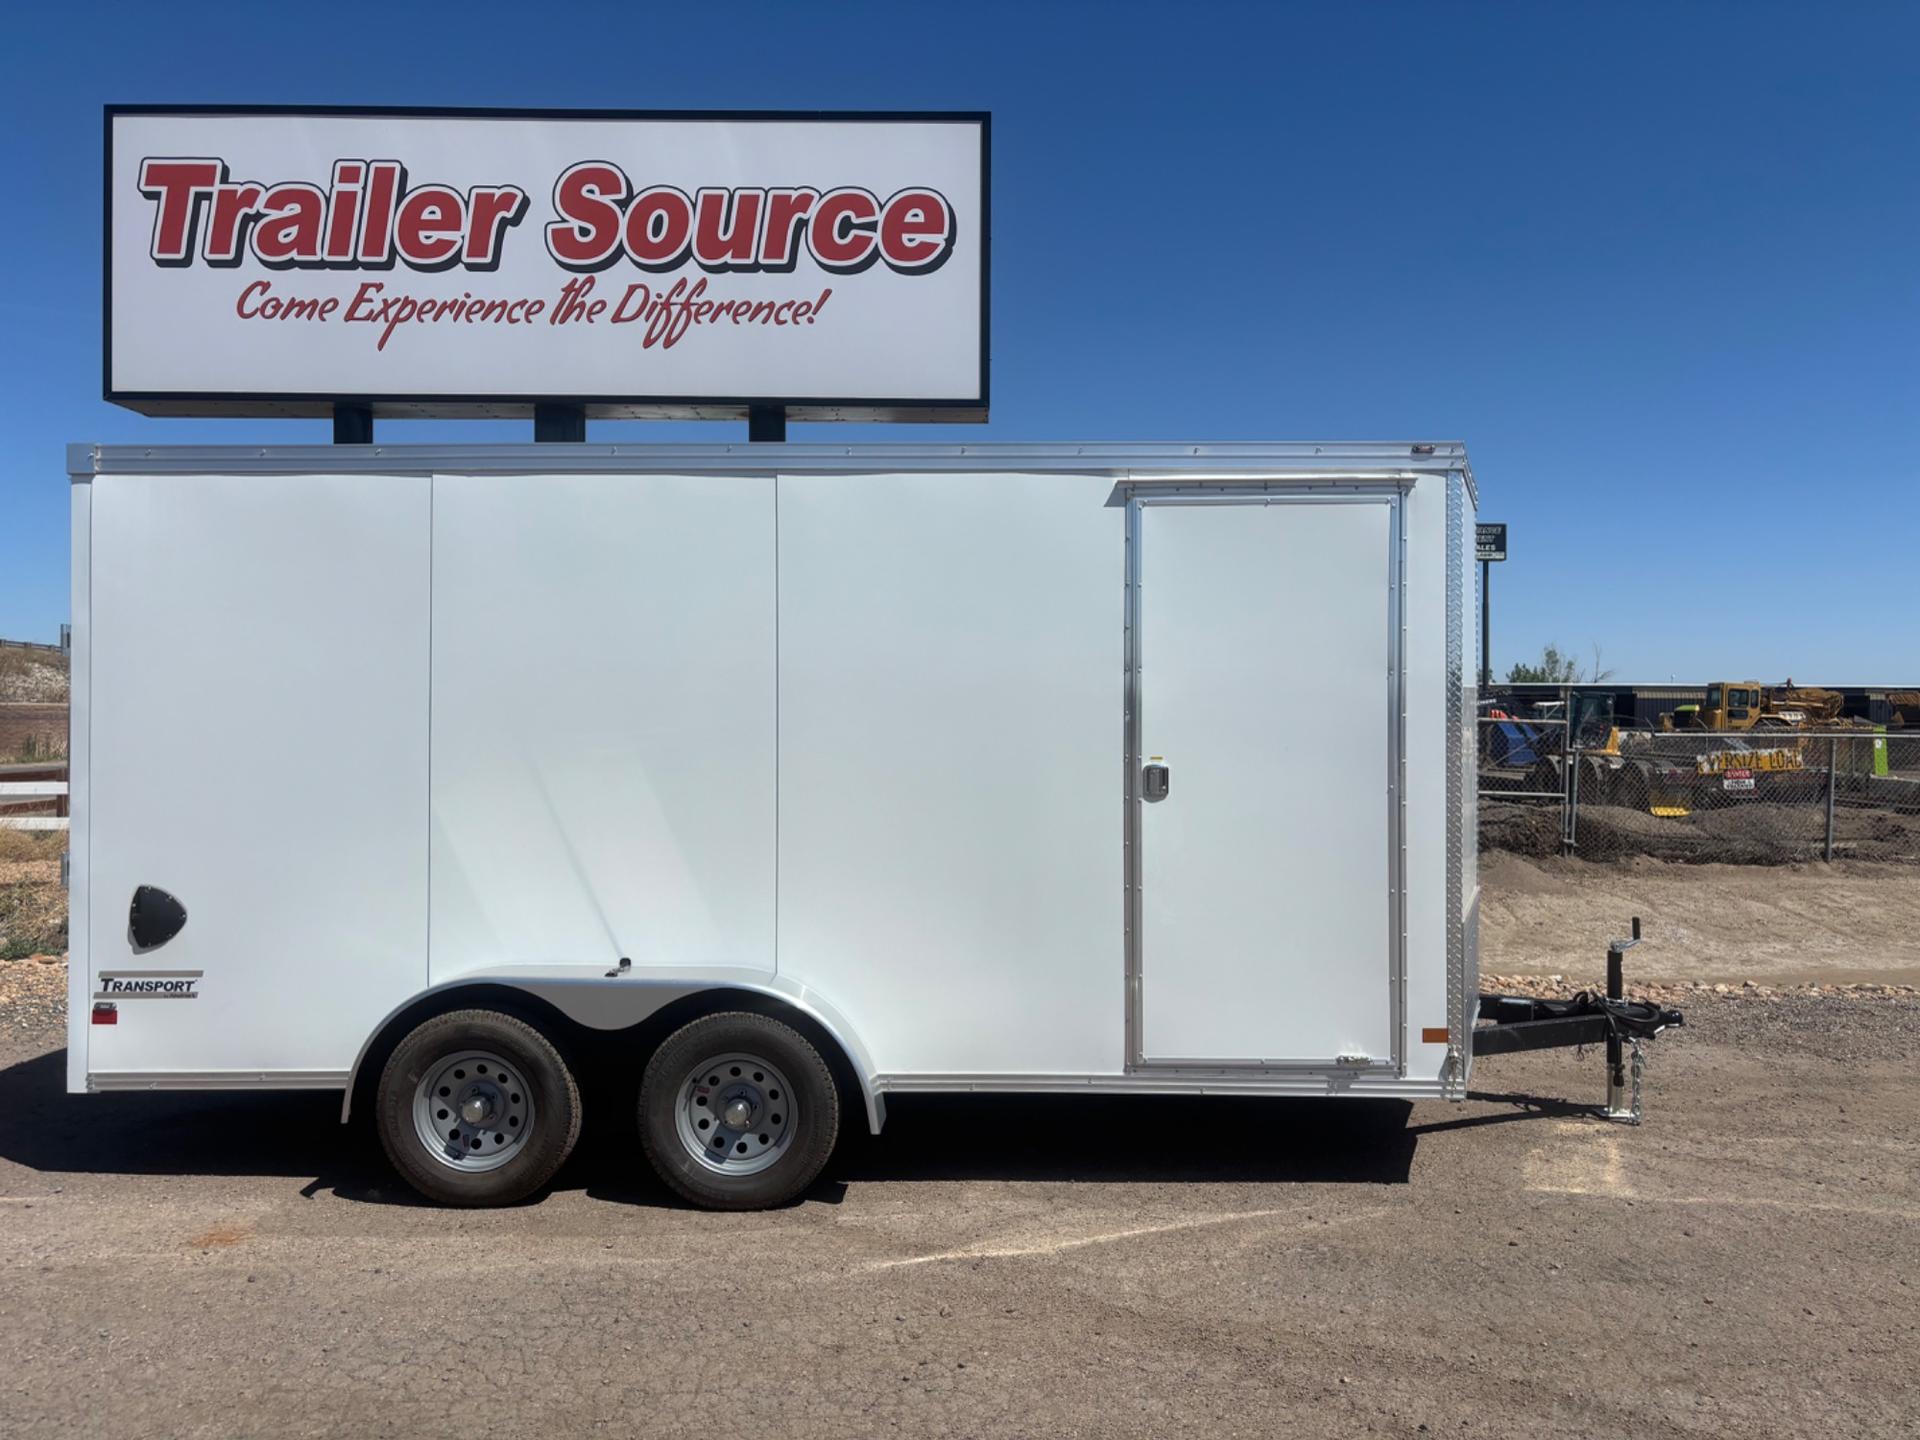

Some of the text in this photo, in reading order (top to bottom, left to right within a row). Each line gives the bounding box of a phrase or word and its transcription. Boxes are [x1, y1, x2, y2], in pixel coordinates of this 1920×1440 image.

[138, 157, 957, 274] Trailer Source
[236, 275, 833, 351] Come Experience the Difference!
[100, 978, 195, 992] TRANSPORT
